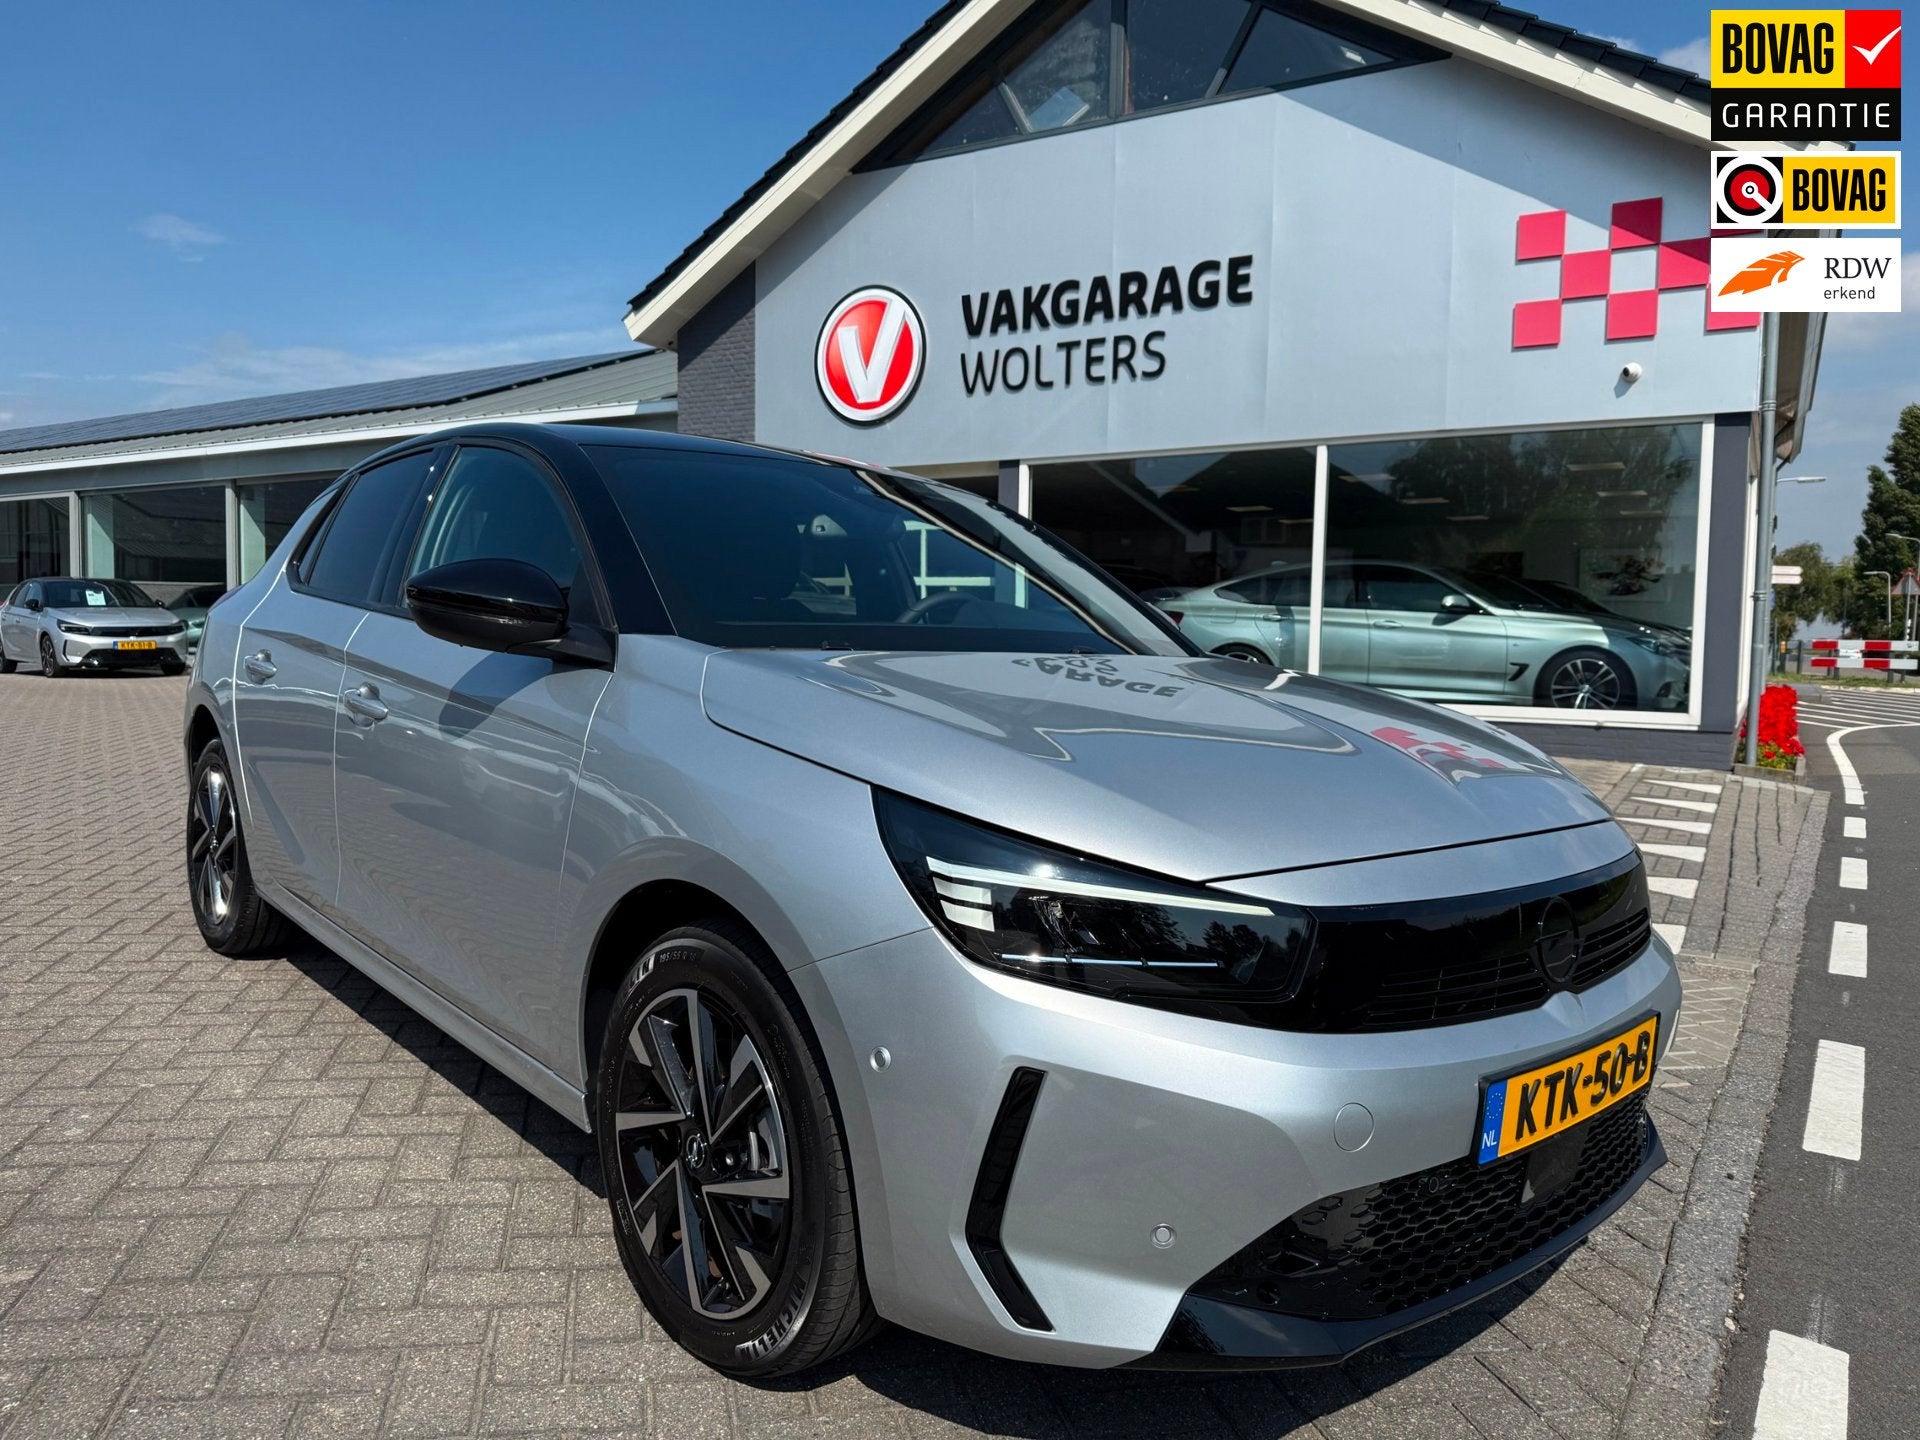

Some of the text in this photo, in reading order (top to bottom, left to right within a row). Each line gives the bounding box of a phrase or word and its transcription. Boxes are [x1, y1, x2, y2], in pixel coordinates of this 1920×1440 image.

[960, 254, 1254, 339] VAKGARAGE
[960, 330, 1166, 396] WOLTERS
[1515, 1030, 1651, 1142] KTK-50-B
[1482, 1129, 1497, 1149] NL
[738, 1272, 808, 1361] MICHELIN
